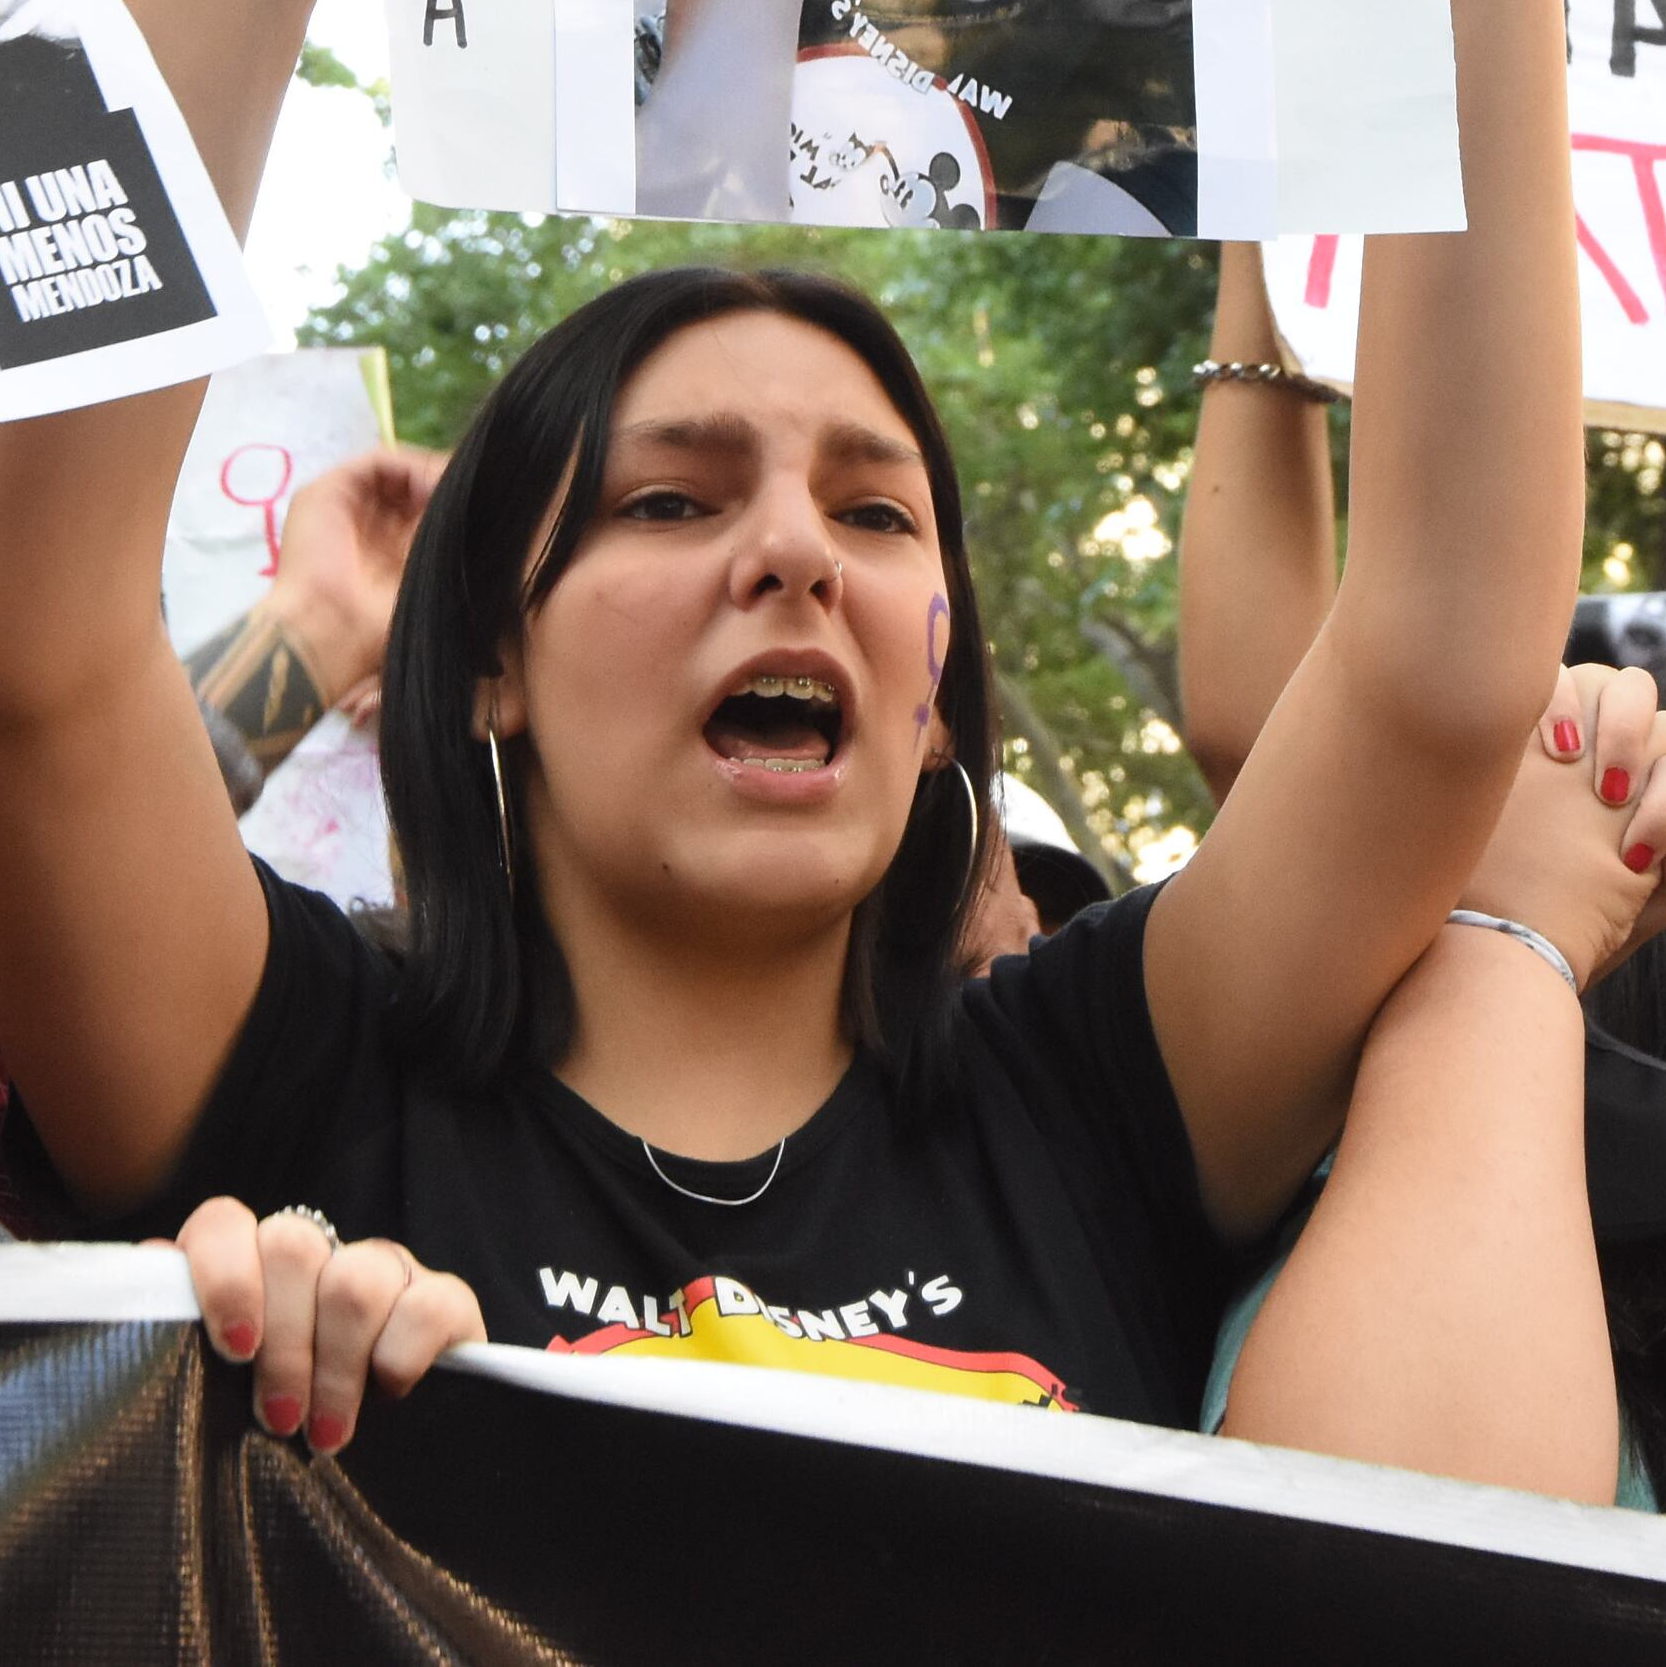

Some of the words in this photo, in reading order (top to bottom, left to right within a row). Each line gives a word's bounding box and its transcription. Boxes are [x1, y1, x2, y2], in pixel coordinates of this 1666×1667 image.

[24, 158, 130, 224] UNA
[10, 254, 163, 324] MENDOZA
[538, 1266, 692, 1337] WALT
[713, 1270, 963, 1342] DISNEY'S
